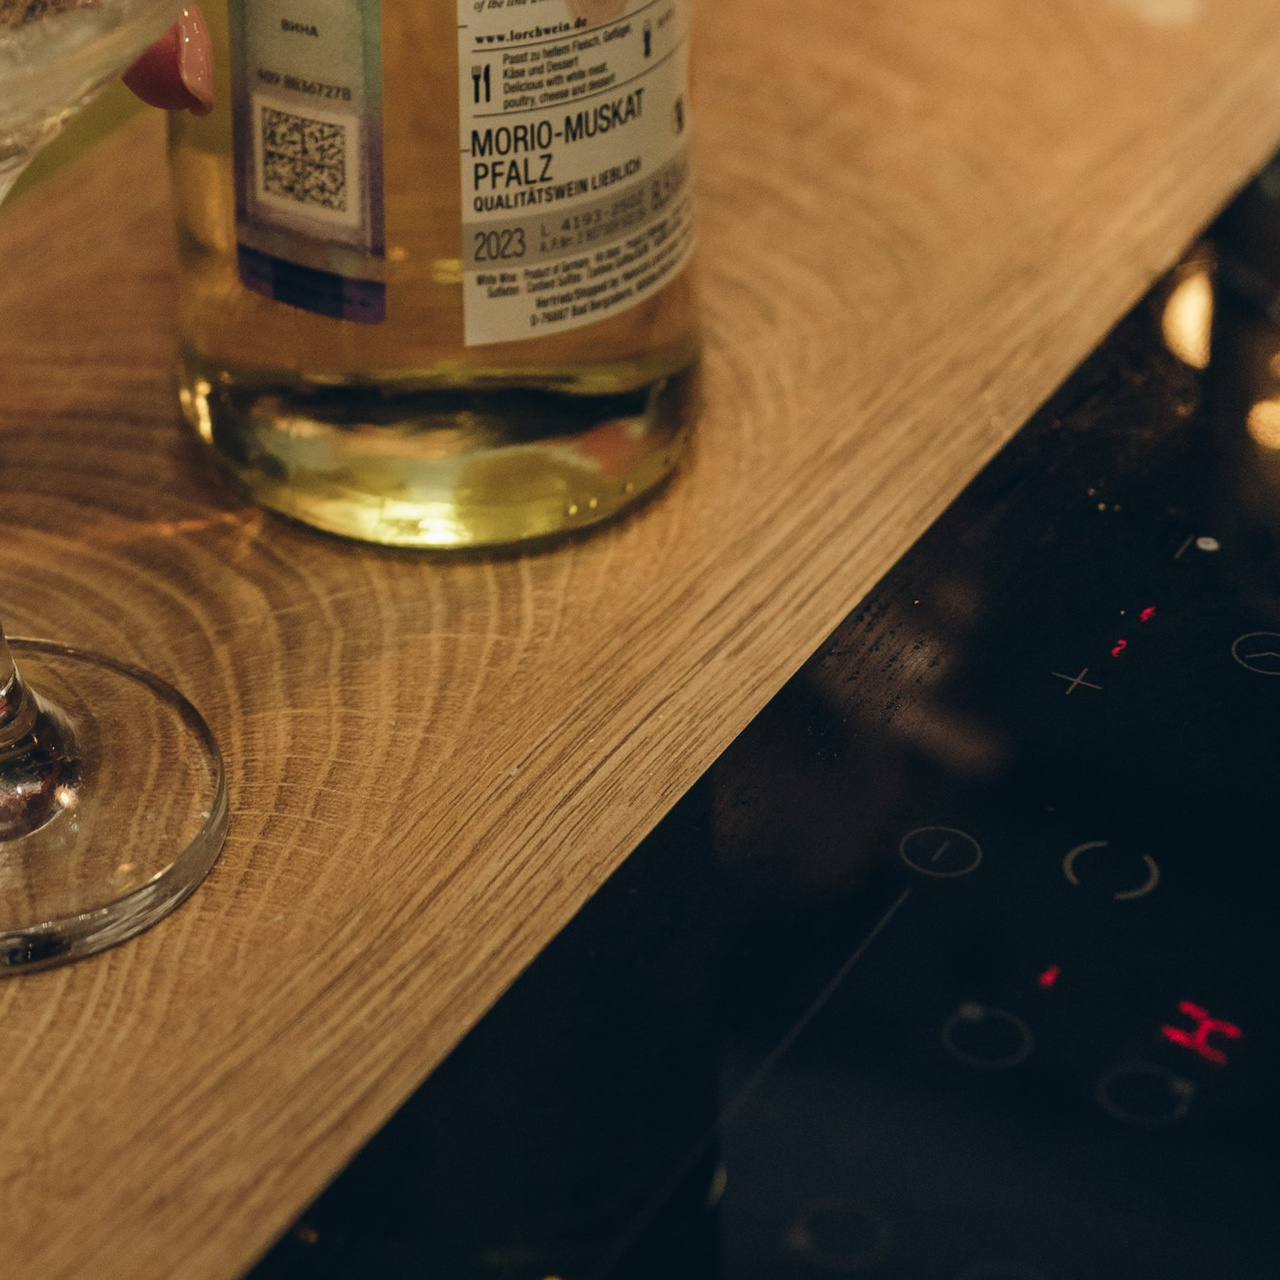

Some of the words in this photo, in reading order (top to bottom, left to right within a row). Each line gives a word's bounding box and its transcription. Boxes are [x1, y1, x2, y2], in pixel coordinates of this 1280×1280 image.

[280, 18, 320, 38] ВИНА
[475, 17, 587, 44] www.lorchwein.de
[471, 88, 645, 158] MORIO-MUSKAT
[473, 153, 554, 191] PFALZ
[473, 177, 589, 213] QUALITÄTSWEIN
[474, 227, 527, 262] 2023
